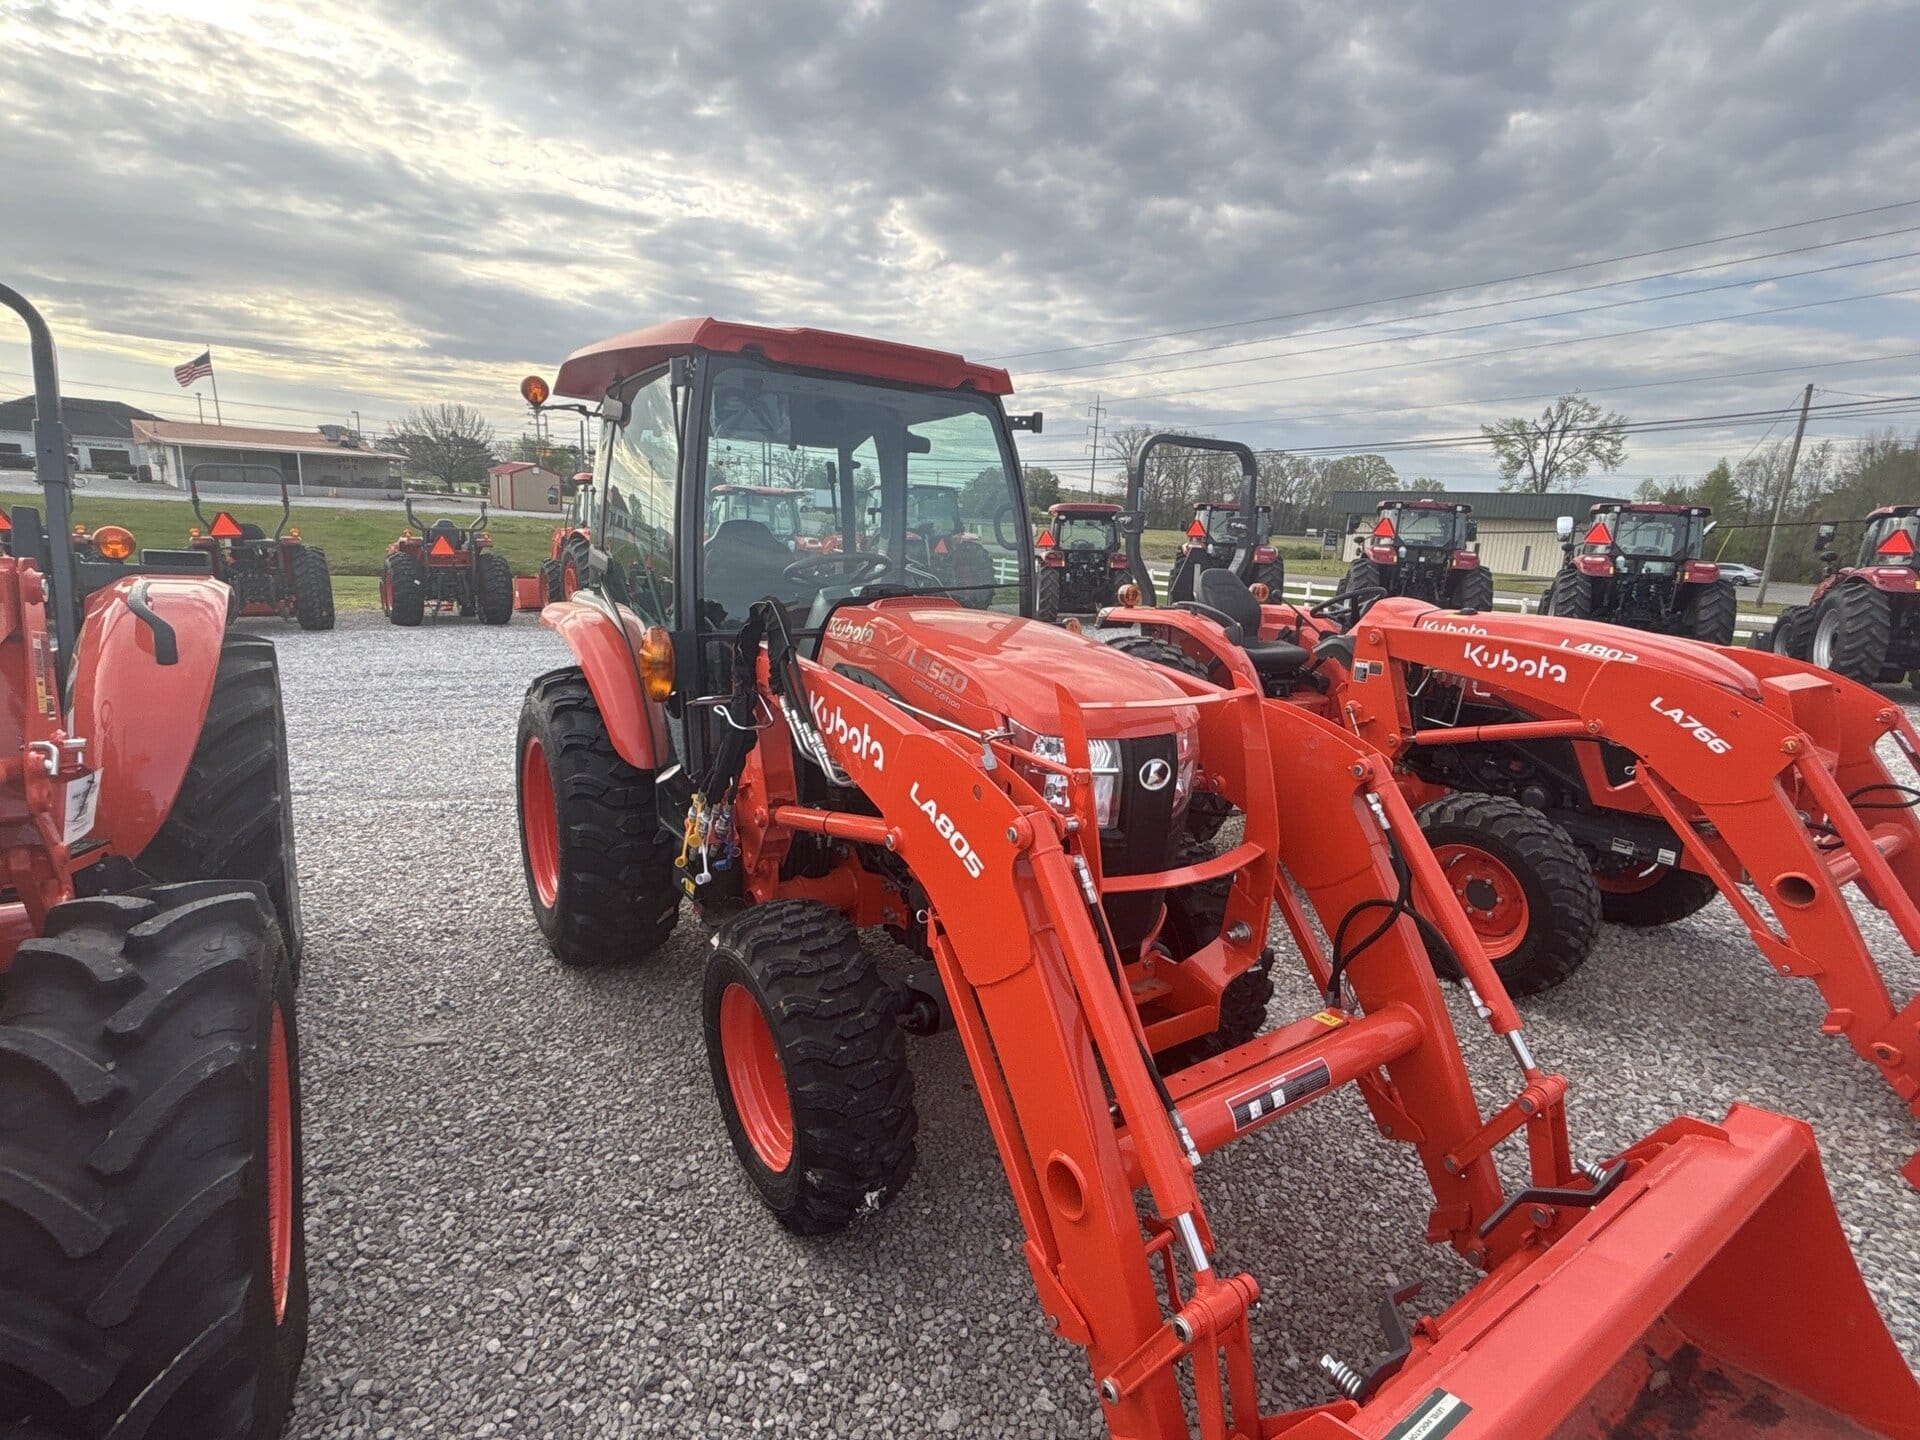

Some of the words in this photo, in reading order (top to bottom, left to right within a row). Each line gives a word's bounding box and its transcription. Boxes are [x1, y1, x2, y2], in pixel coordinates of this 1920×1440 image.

[829, 617, 874, 643] Kubota
[908, 649, 969, 695] L3560
[1464, 641, 1567, 684] Kubota
[911, 675, 934, 693] Limited
[934, 690, 961, 709] Edition
[809, 690, 885, 771] Kubota
[1650, 696, 1732, 755] LA766
[909, 781, 985, 879] LA805
